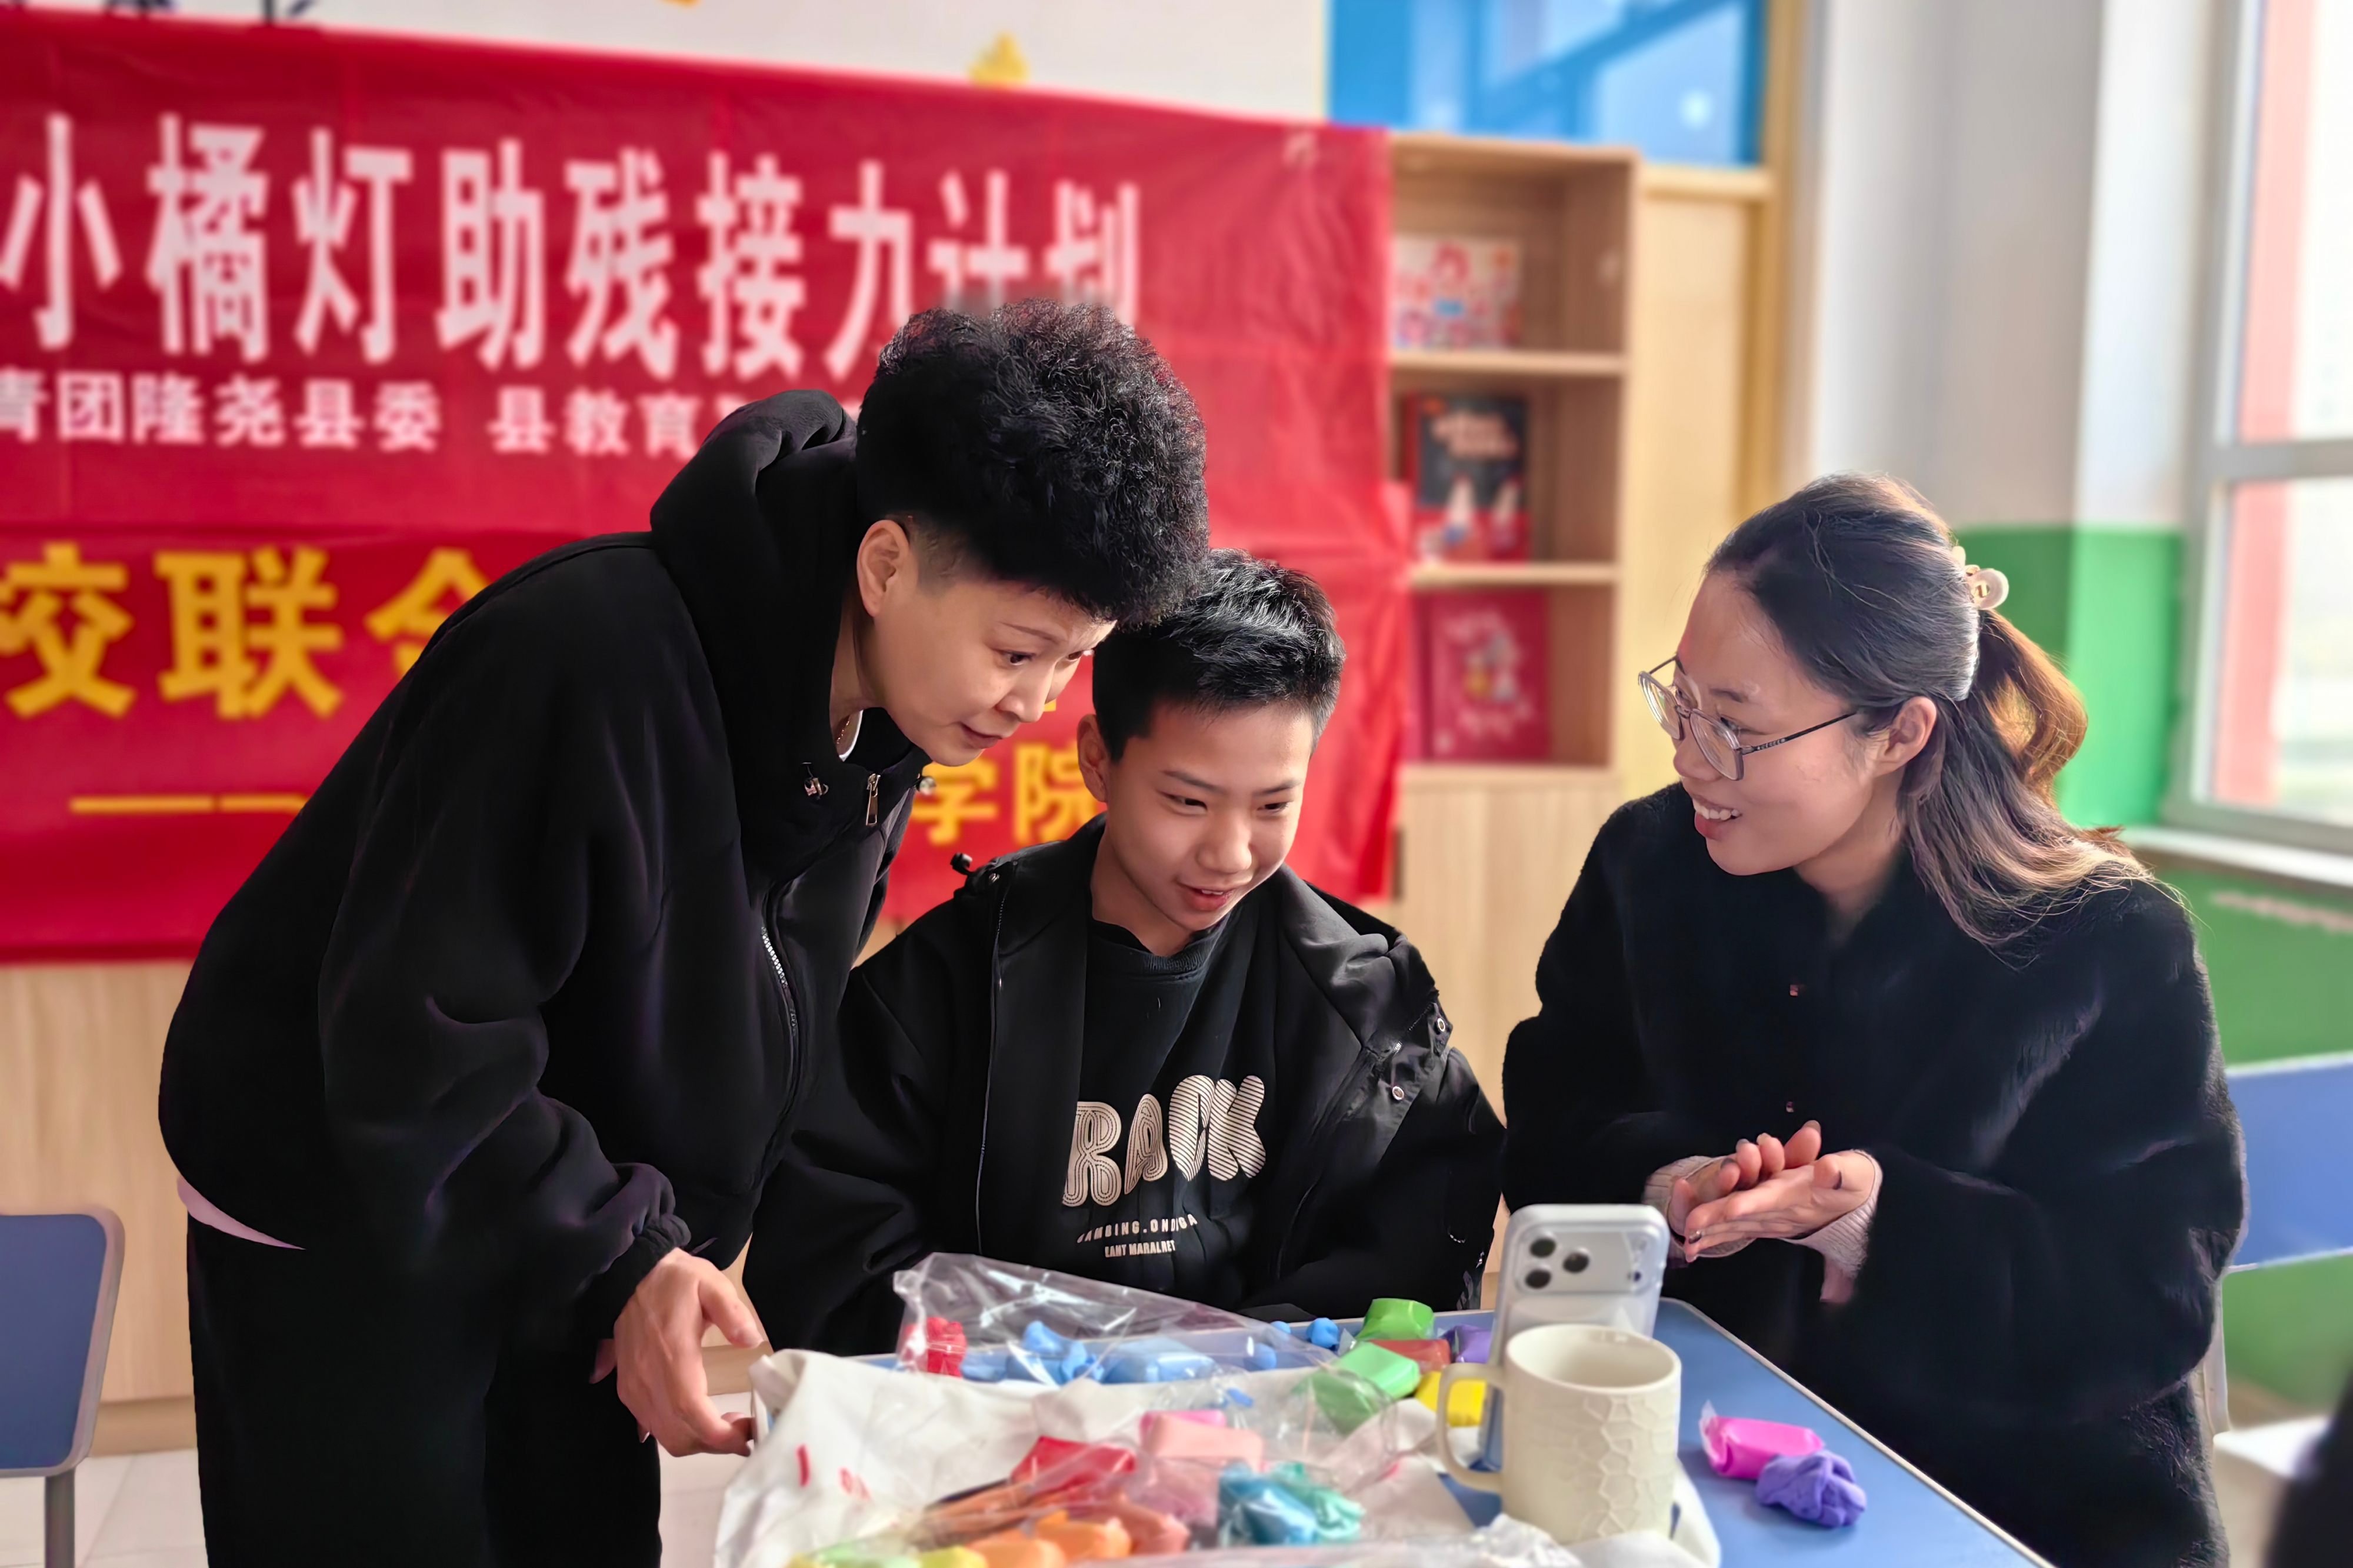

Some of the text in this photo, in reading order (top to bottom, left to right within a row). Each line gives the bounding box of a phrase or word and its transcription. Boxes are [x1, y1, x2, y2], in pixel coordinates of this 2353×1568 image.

[0, 112, 1144, 381] 小橘灯助残接力计划
[487, 383, 746, 462] 县教育
